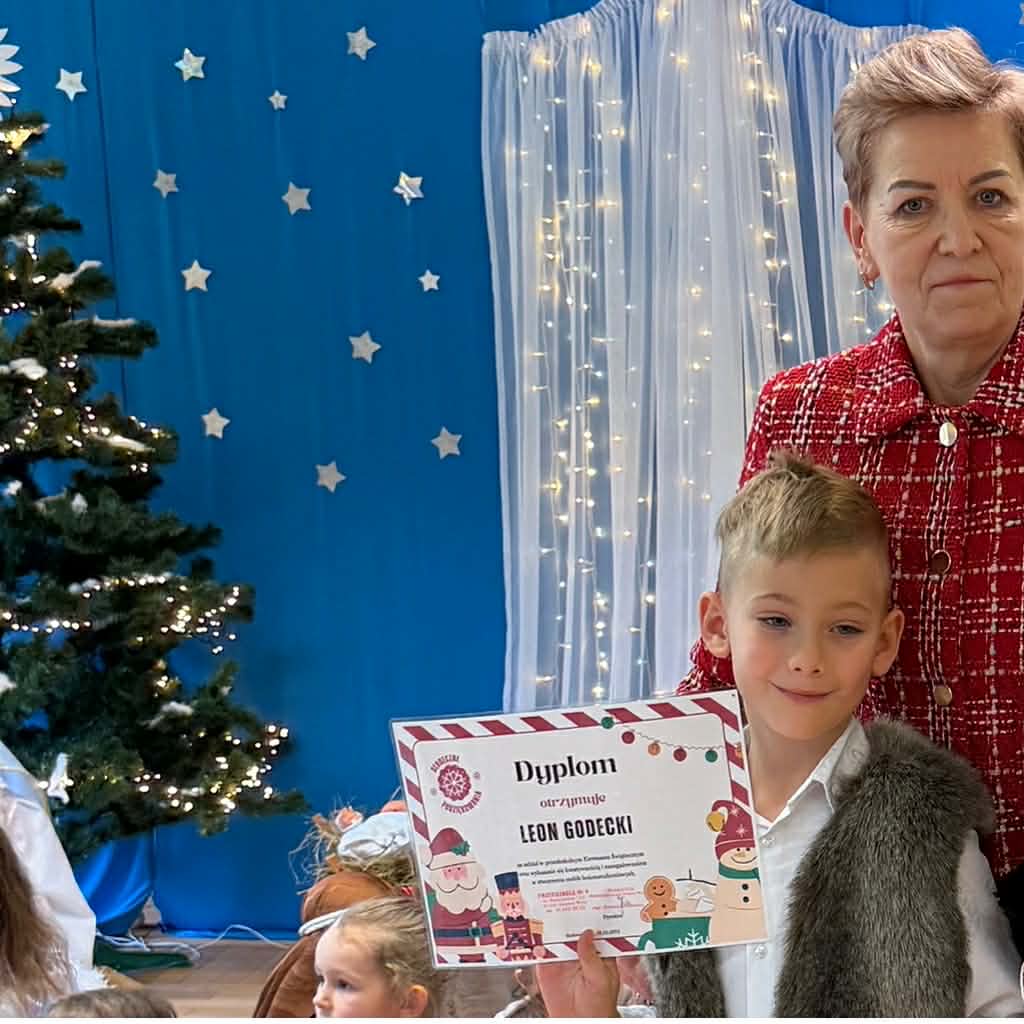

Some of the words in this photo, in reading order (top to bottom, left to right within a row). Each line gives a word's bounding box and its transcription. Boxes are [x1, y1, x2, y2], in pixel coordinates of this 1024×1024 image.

[514, 755, 617, 785] Dyplom
[540, 793, 606, 808] otrzymuje
[520, 822, 559, 844] LEON
[563, 815, 633, 840] GODECKI
